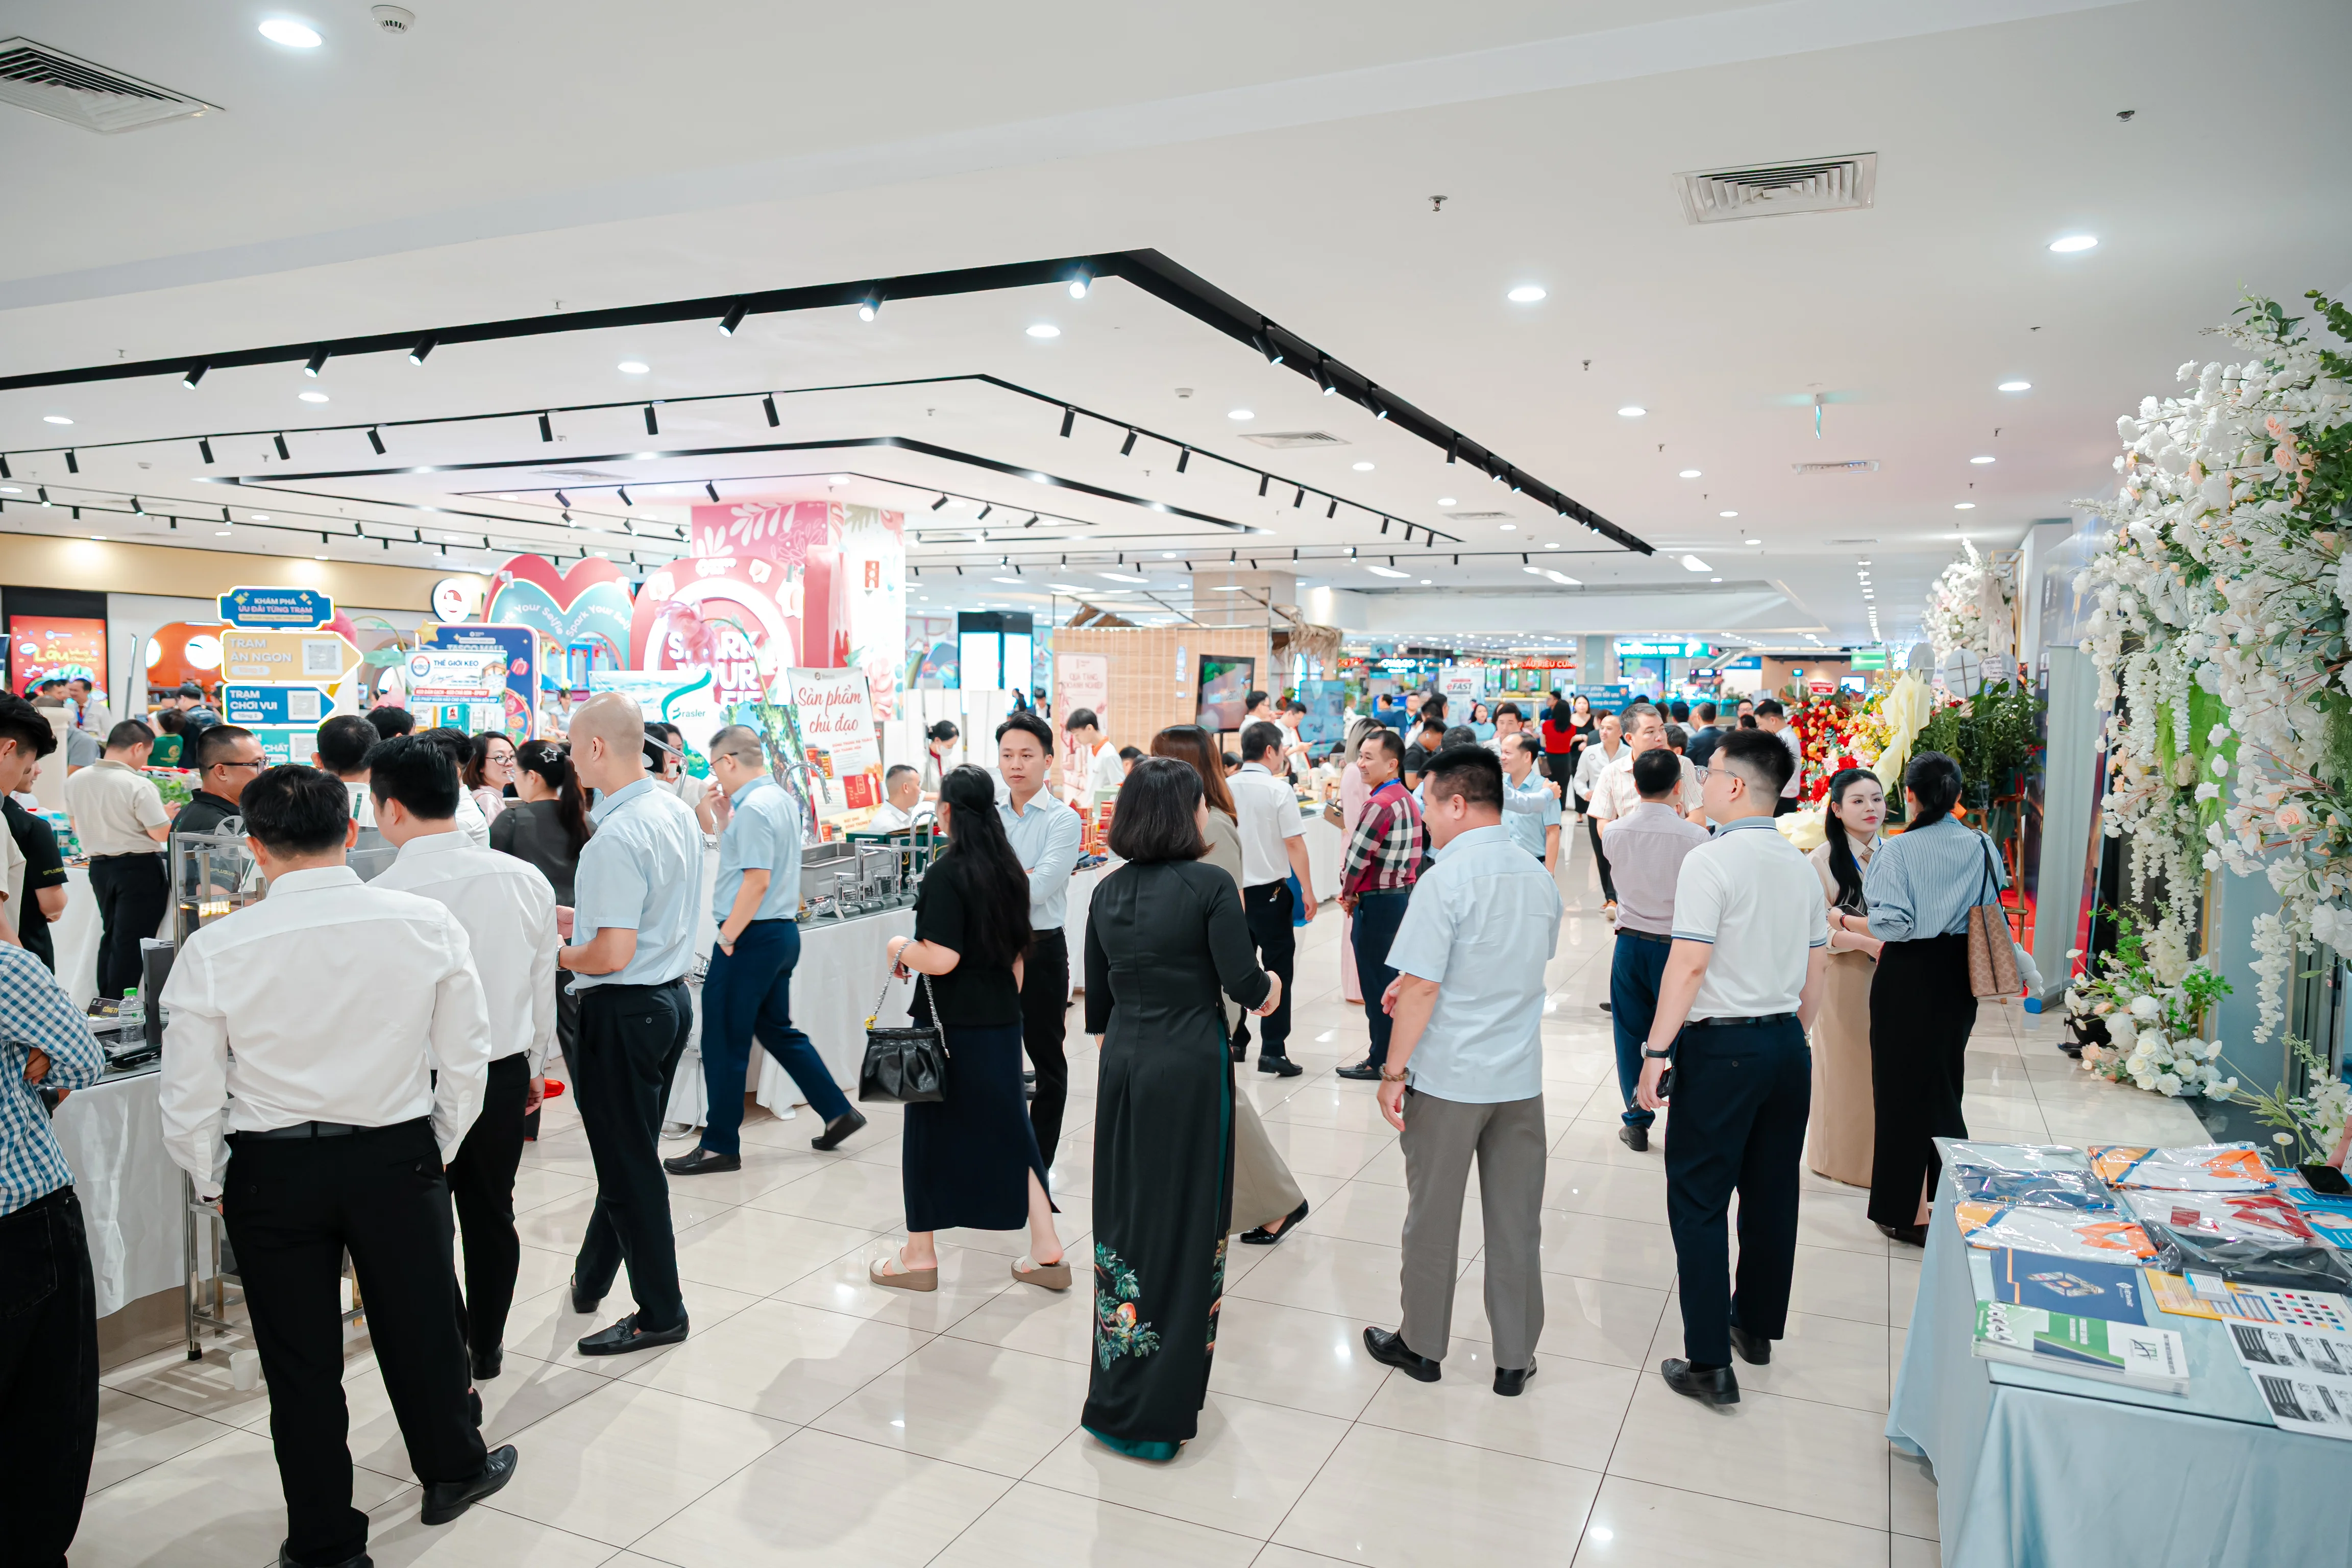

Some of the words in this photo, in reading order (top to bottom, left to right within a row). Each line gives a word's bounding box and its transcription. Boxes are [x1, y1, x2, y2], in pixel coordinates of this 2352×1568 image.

[230, 639, 267, 650] TRẠM
[230, 650, 249, 662] ĂN
[252, 652, 293, 663] NGON
[434, 658, 446, 666] THẾ
[1446, 682, 1474, 691] eFAST
[230, 690, 260, 700] TRẠM
[230, 700, 258, 710] CHƠI
[259, 701, 278, 710] VUI
[798, 687, 823, 706] Sản
[825, 684, 862, 717] phẩm
[810, 714, 831, 733] chủ
[835, 713, 859, 735] đạo
[264, 743, 289, 752] CHẤT
